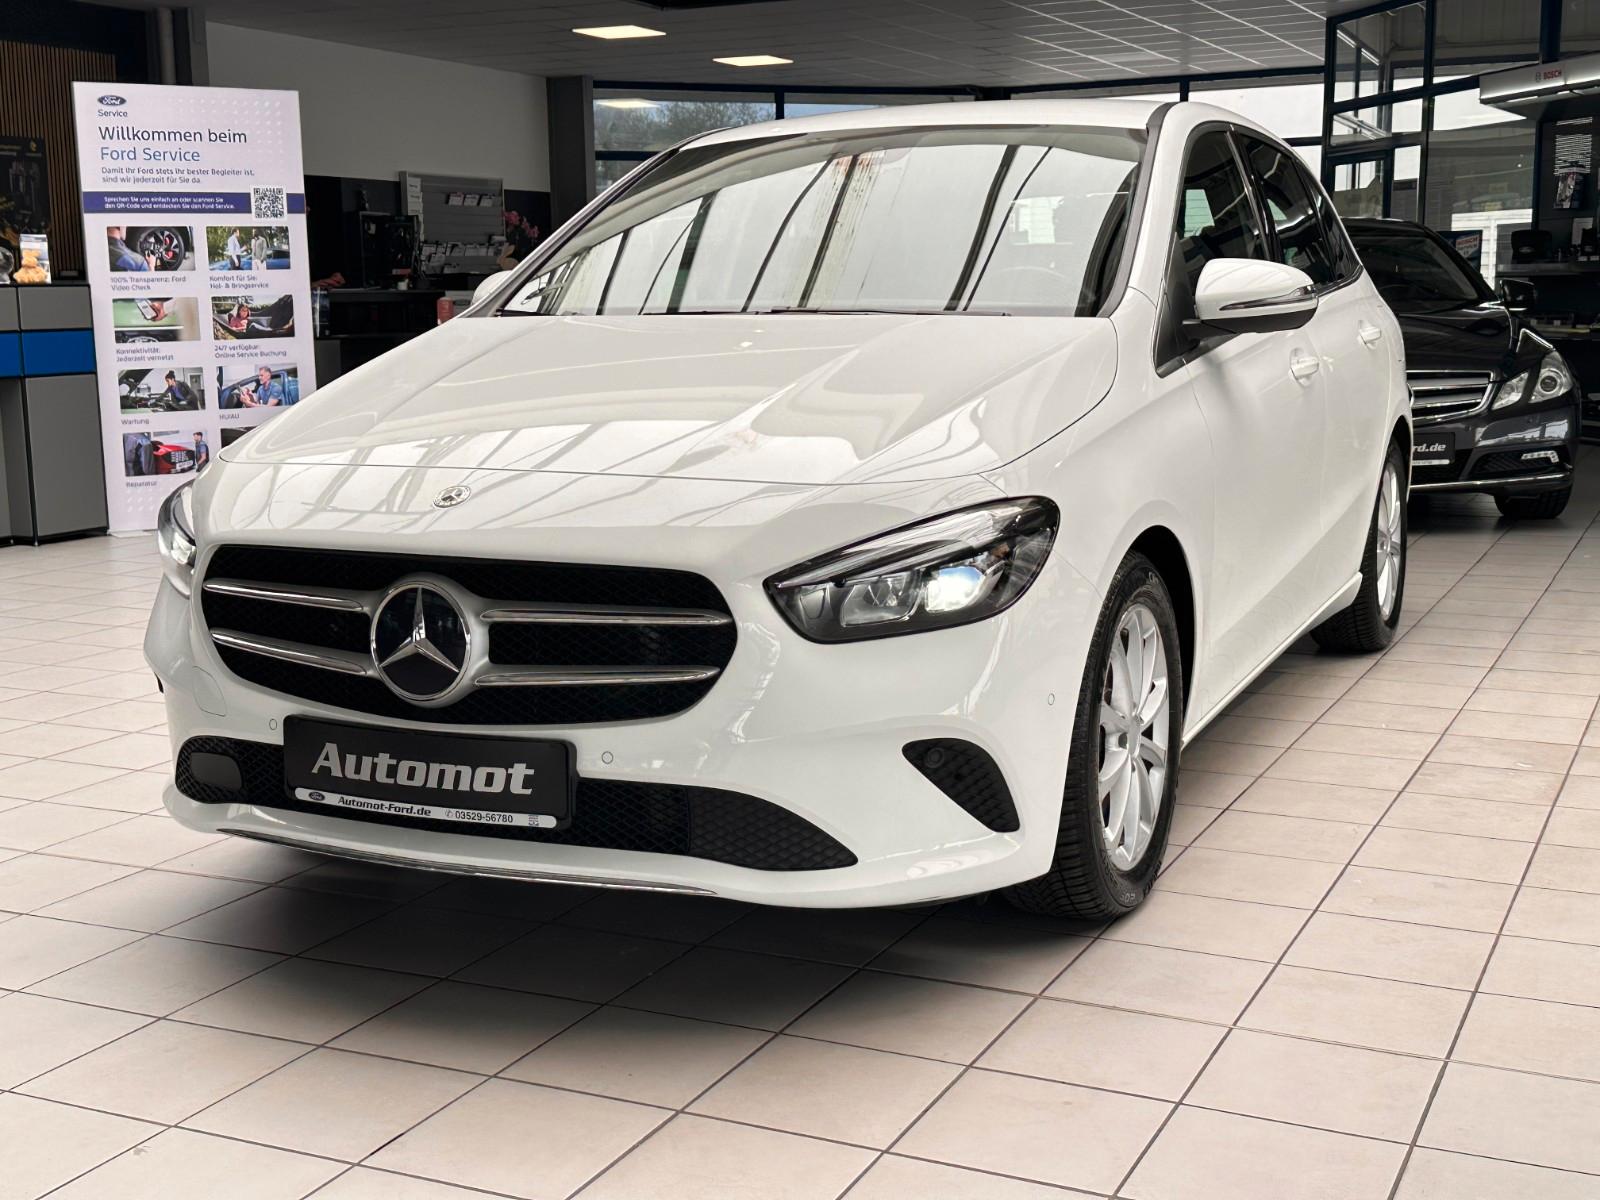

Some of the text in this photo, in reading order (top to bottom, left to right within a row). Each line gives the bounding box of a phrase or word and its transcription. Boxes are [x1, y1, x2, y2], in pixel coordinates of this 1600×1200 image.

[1543, 70, 1562, 80] BOSCH
[98, 109, 128, 117] Service
[99, 126, 247, 143] Willkommen beim
[101, 147, 200, 161] Ford Service
[133, 176, 164, 184] jederzeit
[311, 742, 535, 795] Automot
[337, 796, 431, 817] Automot-Ford.de
[455, 810, 513, 824] 03529-56780
